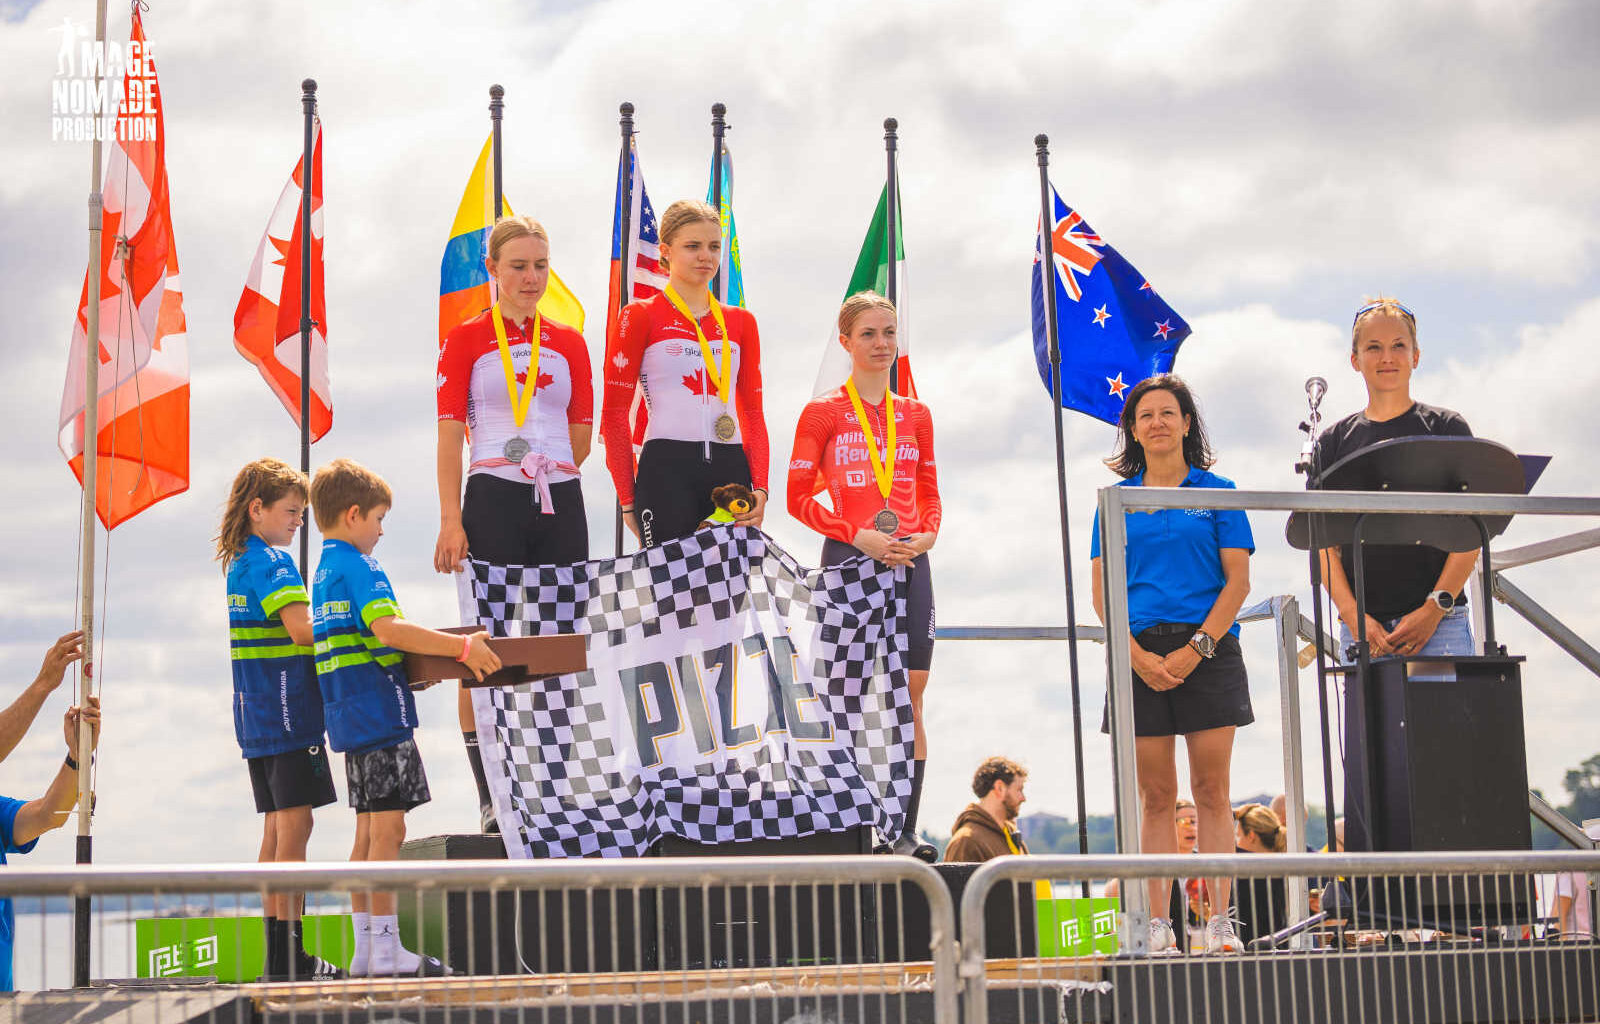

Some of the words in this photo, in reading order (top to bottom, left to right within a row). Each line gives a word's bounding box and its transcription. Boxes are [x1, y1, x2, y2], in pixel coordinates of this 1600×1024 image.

[836, 431, 881, 446] Miltn
[835, 444, 919, 466] Revltion
[642, 509, 654, 547] Cana
